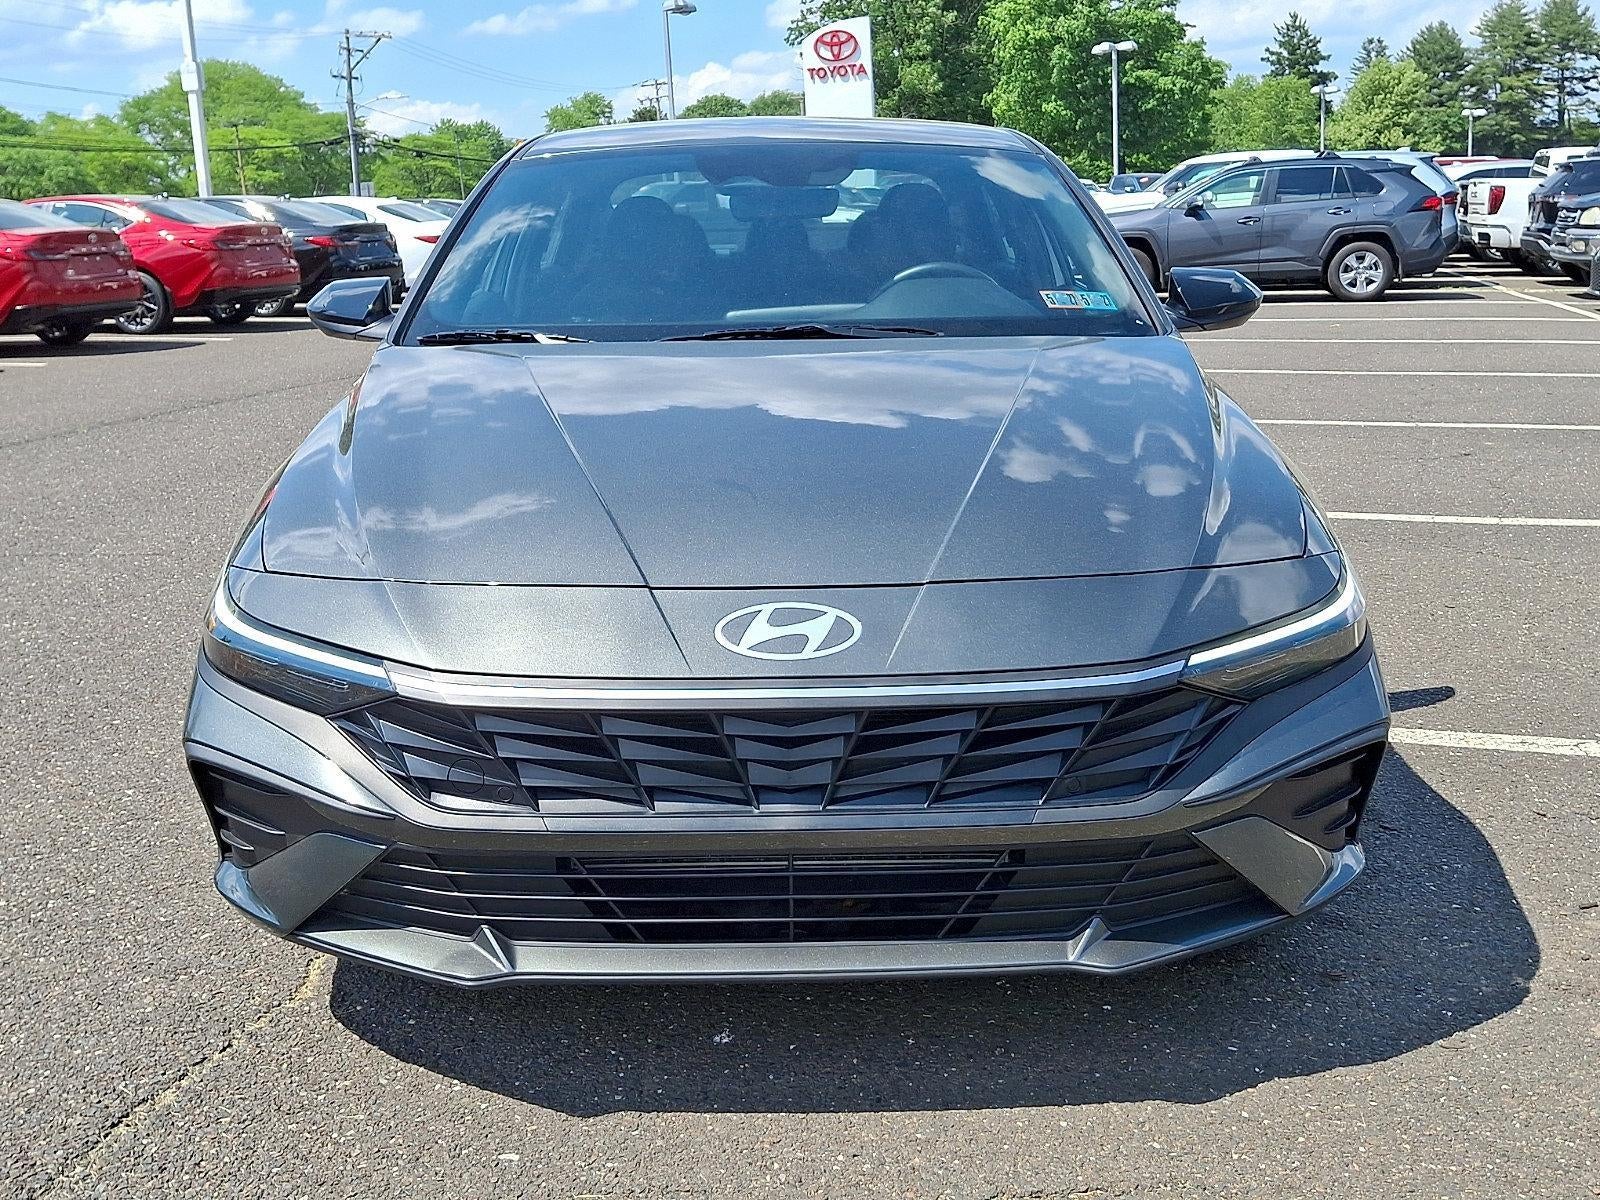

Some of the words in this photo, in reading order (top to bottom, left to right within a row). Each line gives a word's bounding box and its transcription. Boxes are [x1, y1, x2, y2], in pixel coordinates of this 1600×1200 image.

[807, 63, 867, 80] TOYOTA
[1045, 293, 1057, 306] 5
[1080, 294, 1091, 307] 5
